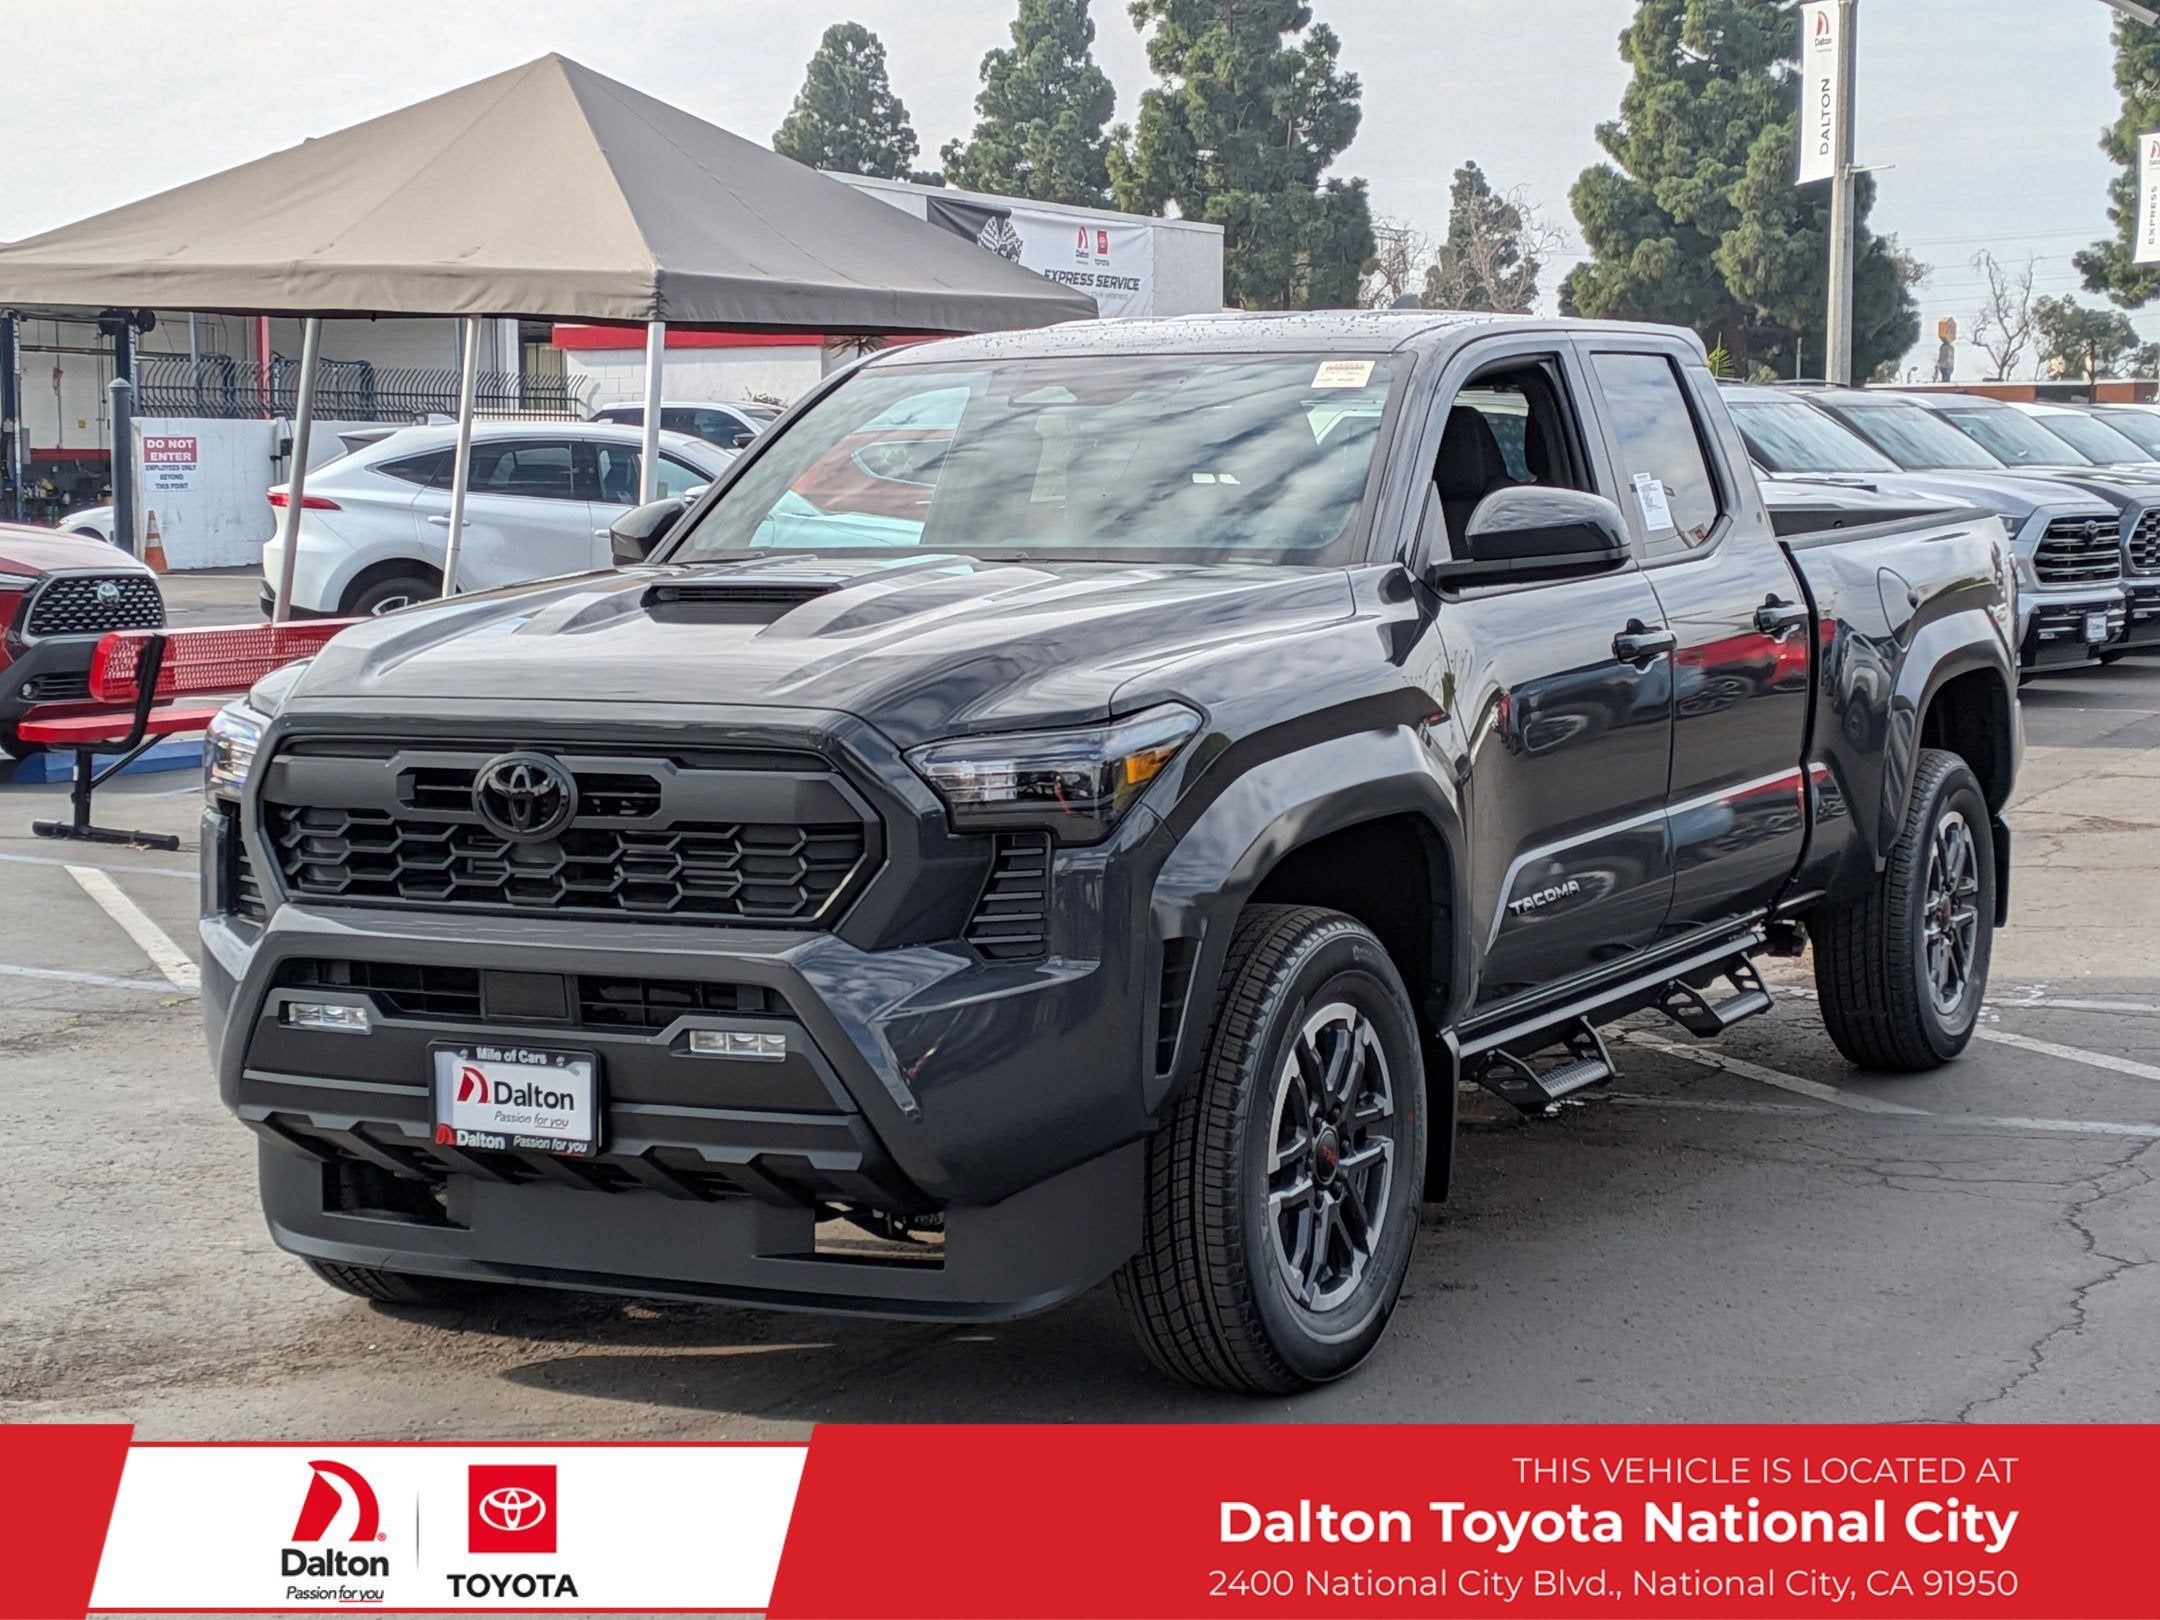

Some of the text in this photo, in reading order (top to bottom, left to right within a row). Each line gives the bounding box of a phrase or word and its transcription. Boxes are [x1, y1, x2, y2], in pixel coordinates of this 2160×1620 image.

[1820, 78, 1831, 156] DALTON
[2148, 186, 2158, 245] EXPRESS
[1044, 269, 1141, 291] EXPRESS SERVICE
[146, 439, 194, 449] DO NOT
[150, 452, 192, 462] ENTER
[1508, 880, 1581, 915] TACOMA
[476, 1047, 547, 1064] Mile of Cars
[494, 1081, 575, 1110] Dalton
[494, 1110, 569, 1129] Passion for you
[456, 1130, 588, 1153] Dalton Passion for you
